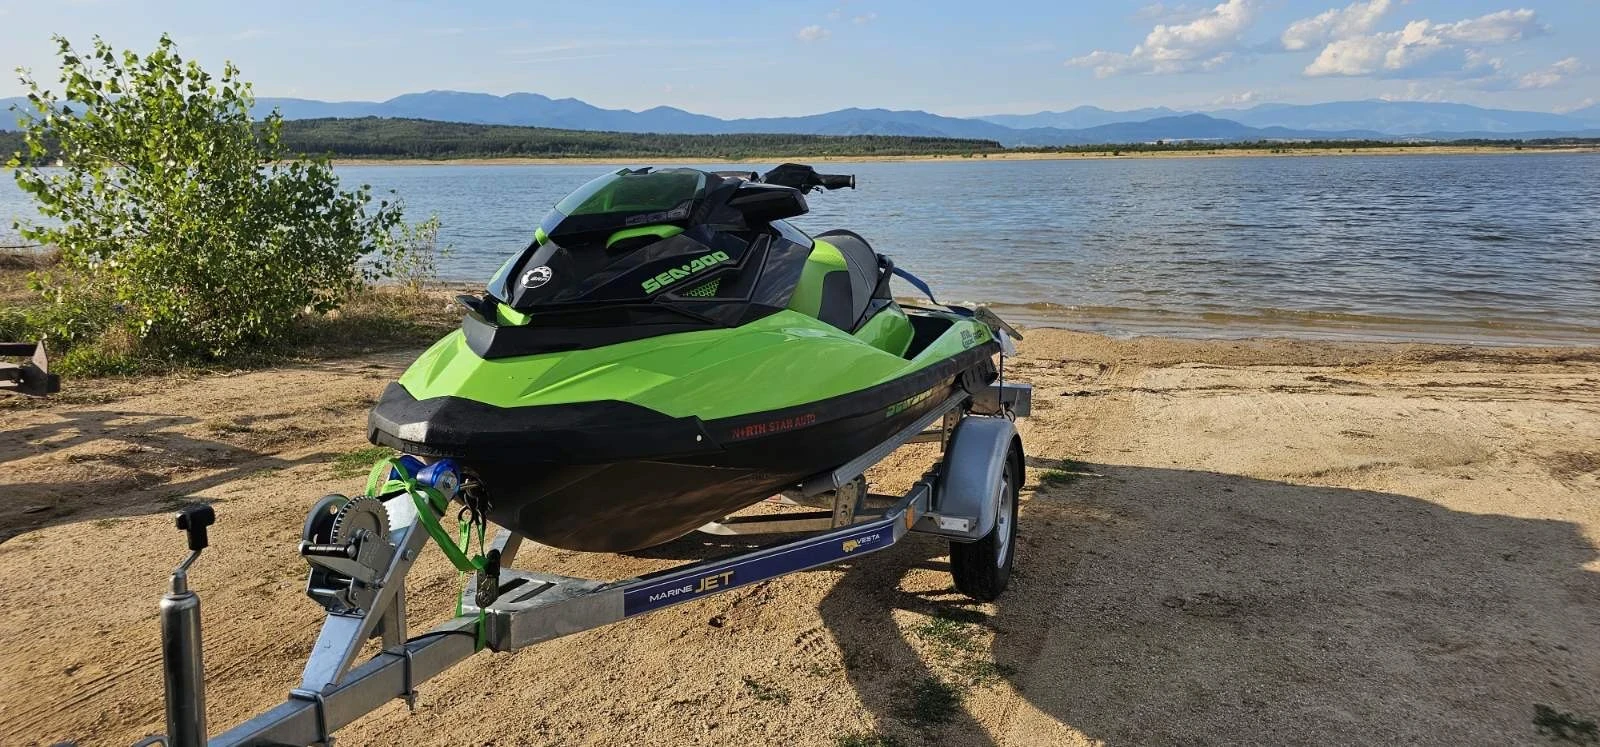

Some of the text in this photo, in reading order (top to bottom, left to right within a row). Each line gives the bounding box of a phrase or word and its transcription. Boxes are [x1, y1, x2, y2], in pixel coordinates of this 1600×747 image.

[856, 533, 880, 544] VESTA
[649, 570, 734, 602] MARINE JET
